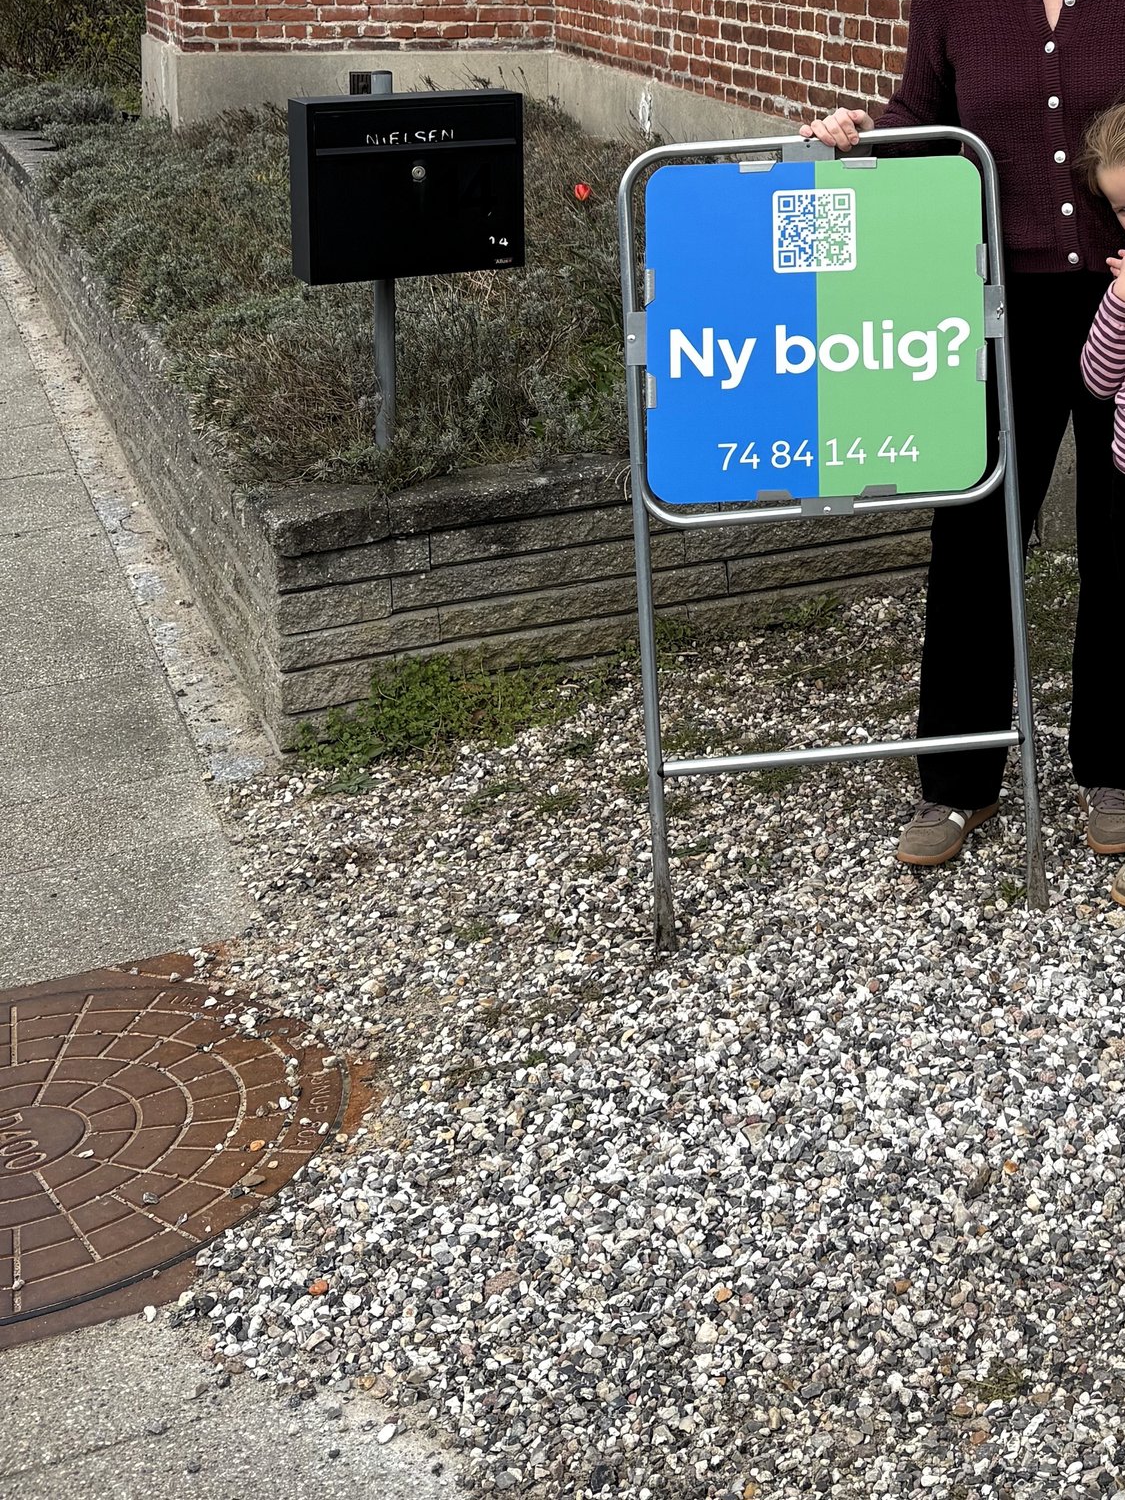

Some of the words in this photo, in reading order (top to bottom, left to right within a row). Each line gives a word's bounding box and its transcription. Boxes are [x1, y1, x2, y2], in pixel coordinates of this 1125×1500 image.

[669, 327, 757, 390] Ny
[775, 316, 971, 382] bolig?
[717, 442, 760, 471] 74
[771, 440, 814, 468] 84
[825, 437, 867, 466] 14
[877, 434, 920, 463] 44
